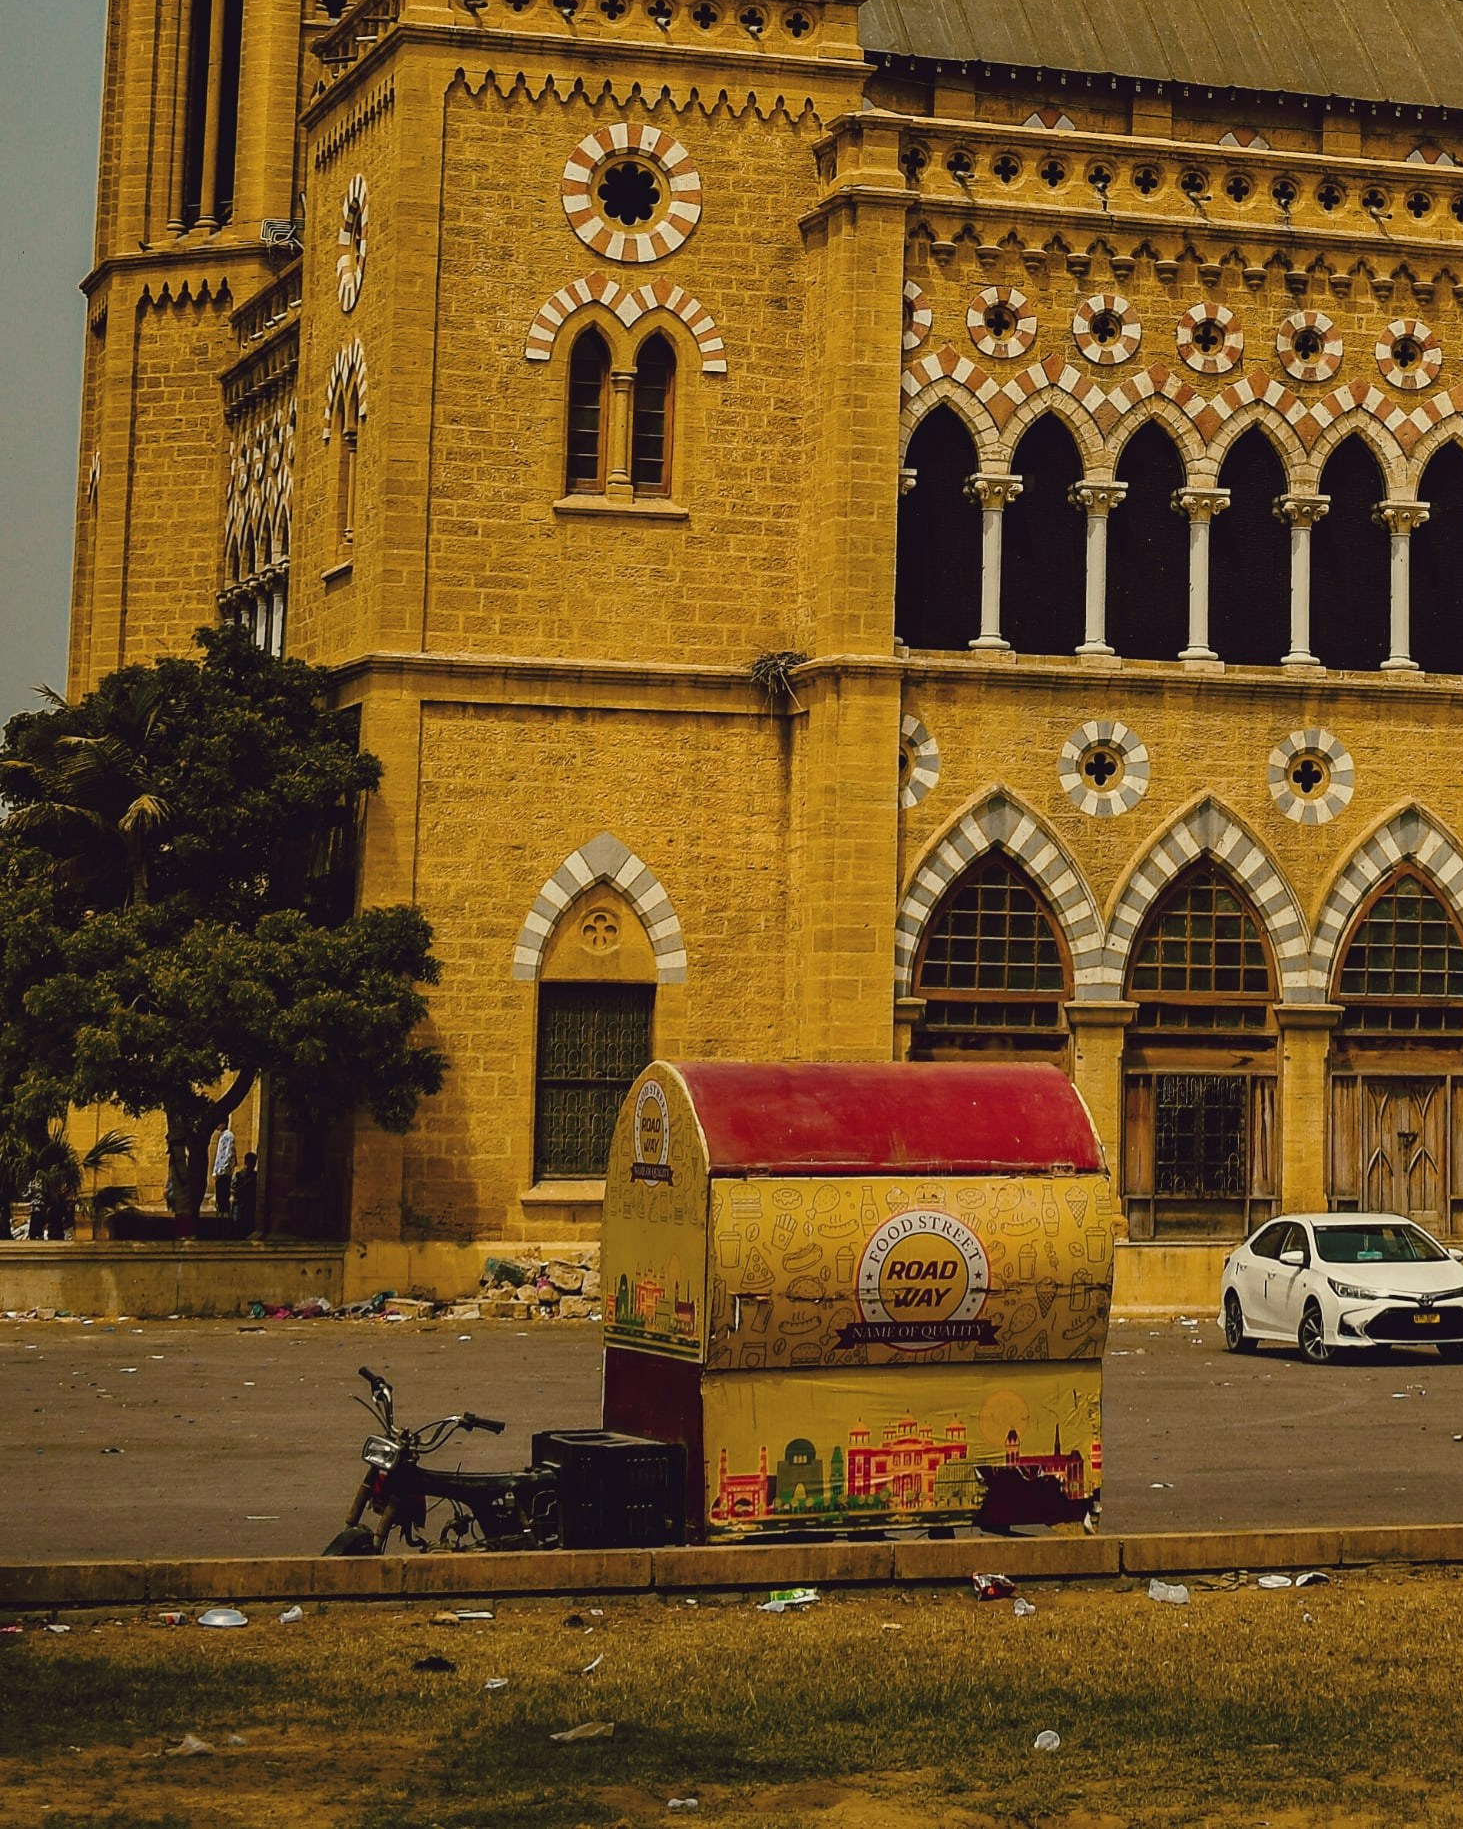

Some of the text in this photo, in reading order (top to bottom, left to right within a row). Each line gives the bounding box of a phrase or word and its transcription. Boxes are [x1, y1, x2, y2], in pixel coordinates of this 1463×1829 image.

[641, 1117, 661, 1132] ROAD
[643, 1138, 659, 1153] WAY
[868, 1215, 982, 1264] FOOD STREET
[886, 1260, 959, 1280] ROAD
[893, 1287, 952, 1308] WAY
[852, 1324, 985, 1340] NAME OF QUALITY
